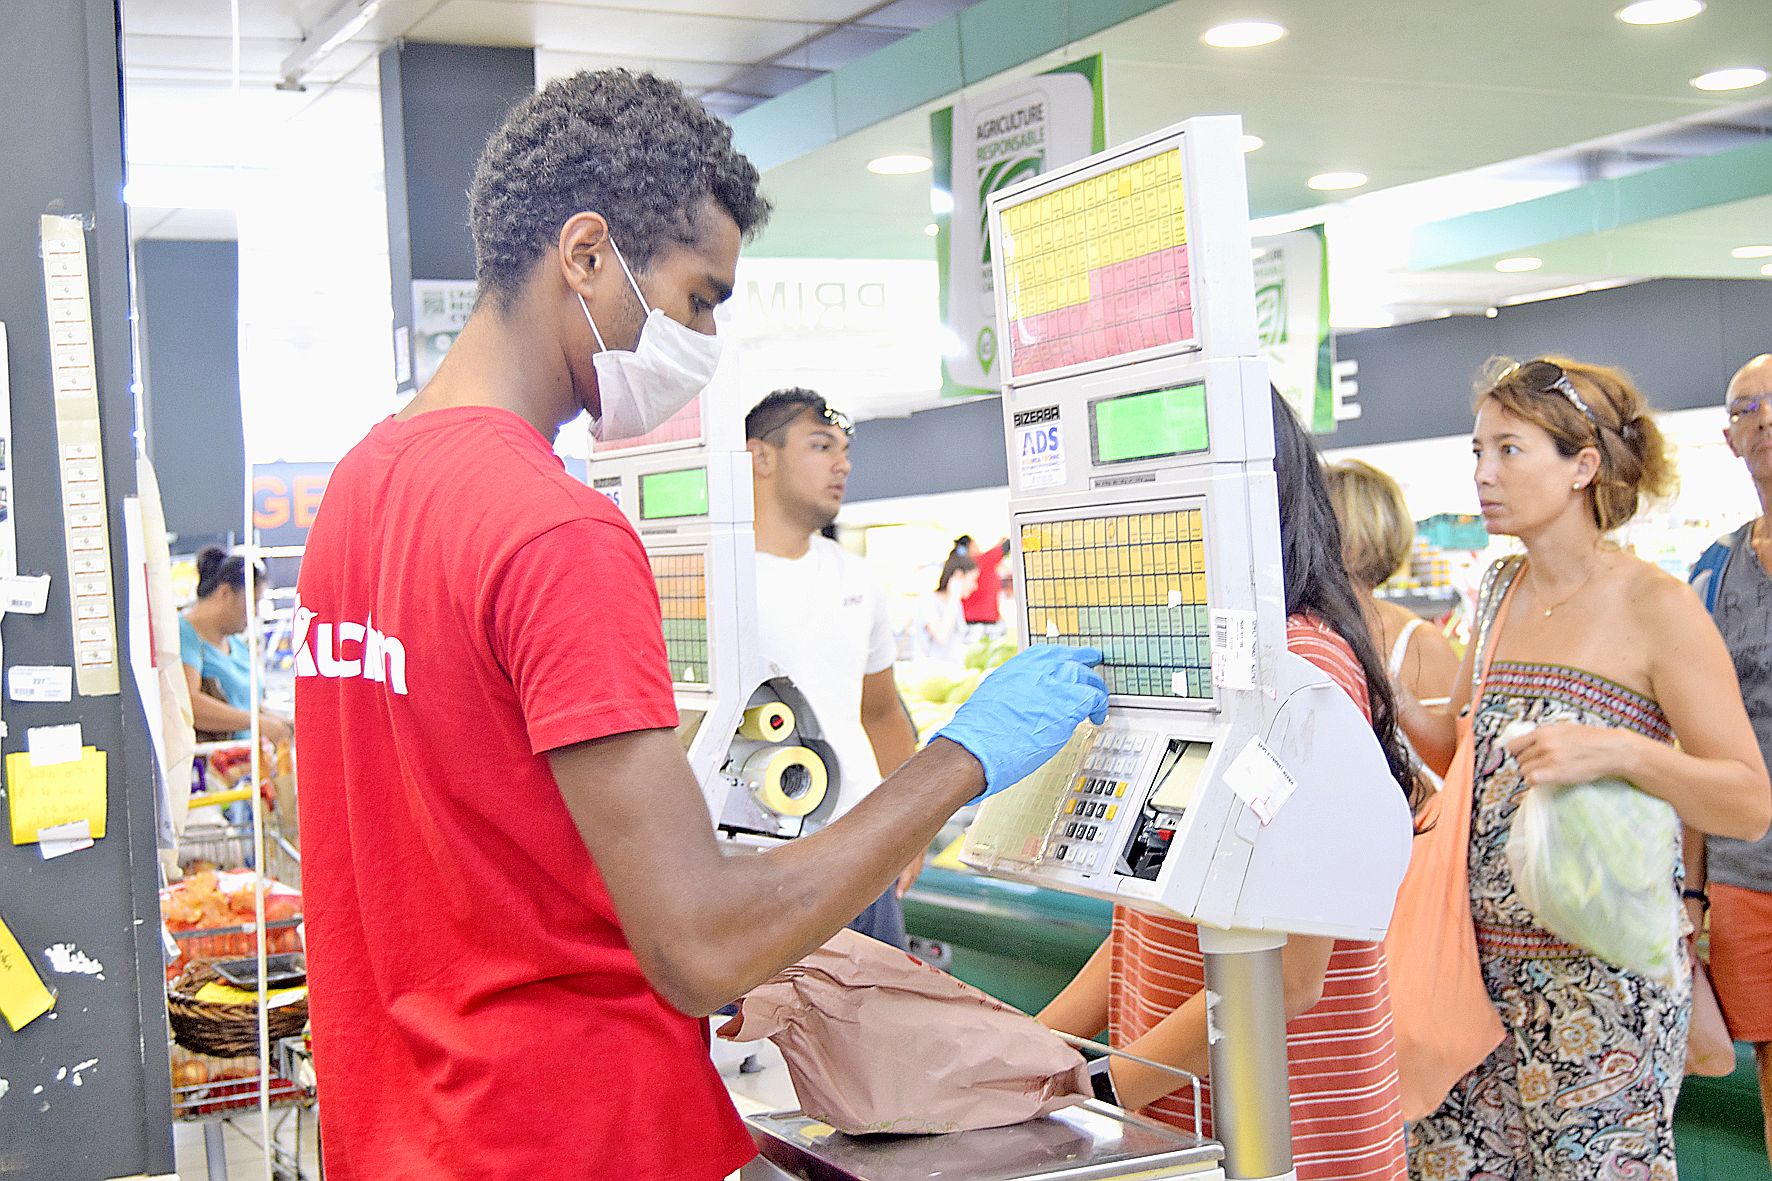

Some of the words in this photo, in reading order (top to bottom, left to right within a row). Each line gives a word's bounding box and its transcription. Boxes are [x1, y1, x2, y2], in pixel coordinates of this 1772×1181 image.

[977, 103, 1043, 139] AGRICULTURE
[977, 127, 1044, 160] RESPONSABLE
[1014, 406, 1059, 427] BIZERBA
[1023, 427, 1058, 456] ADS
